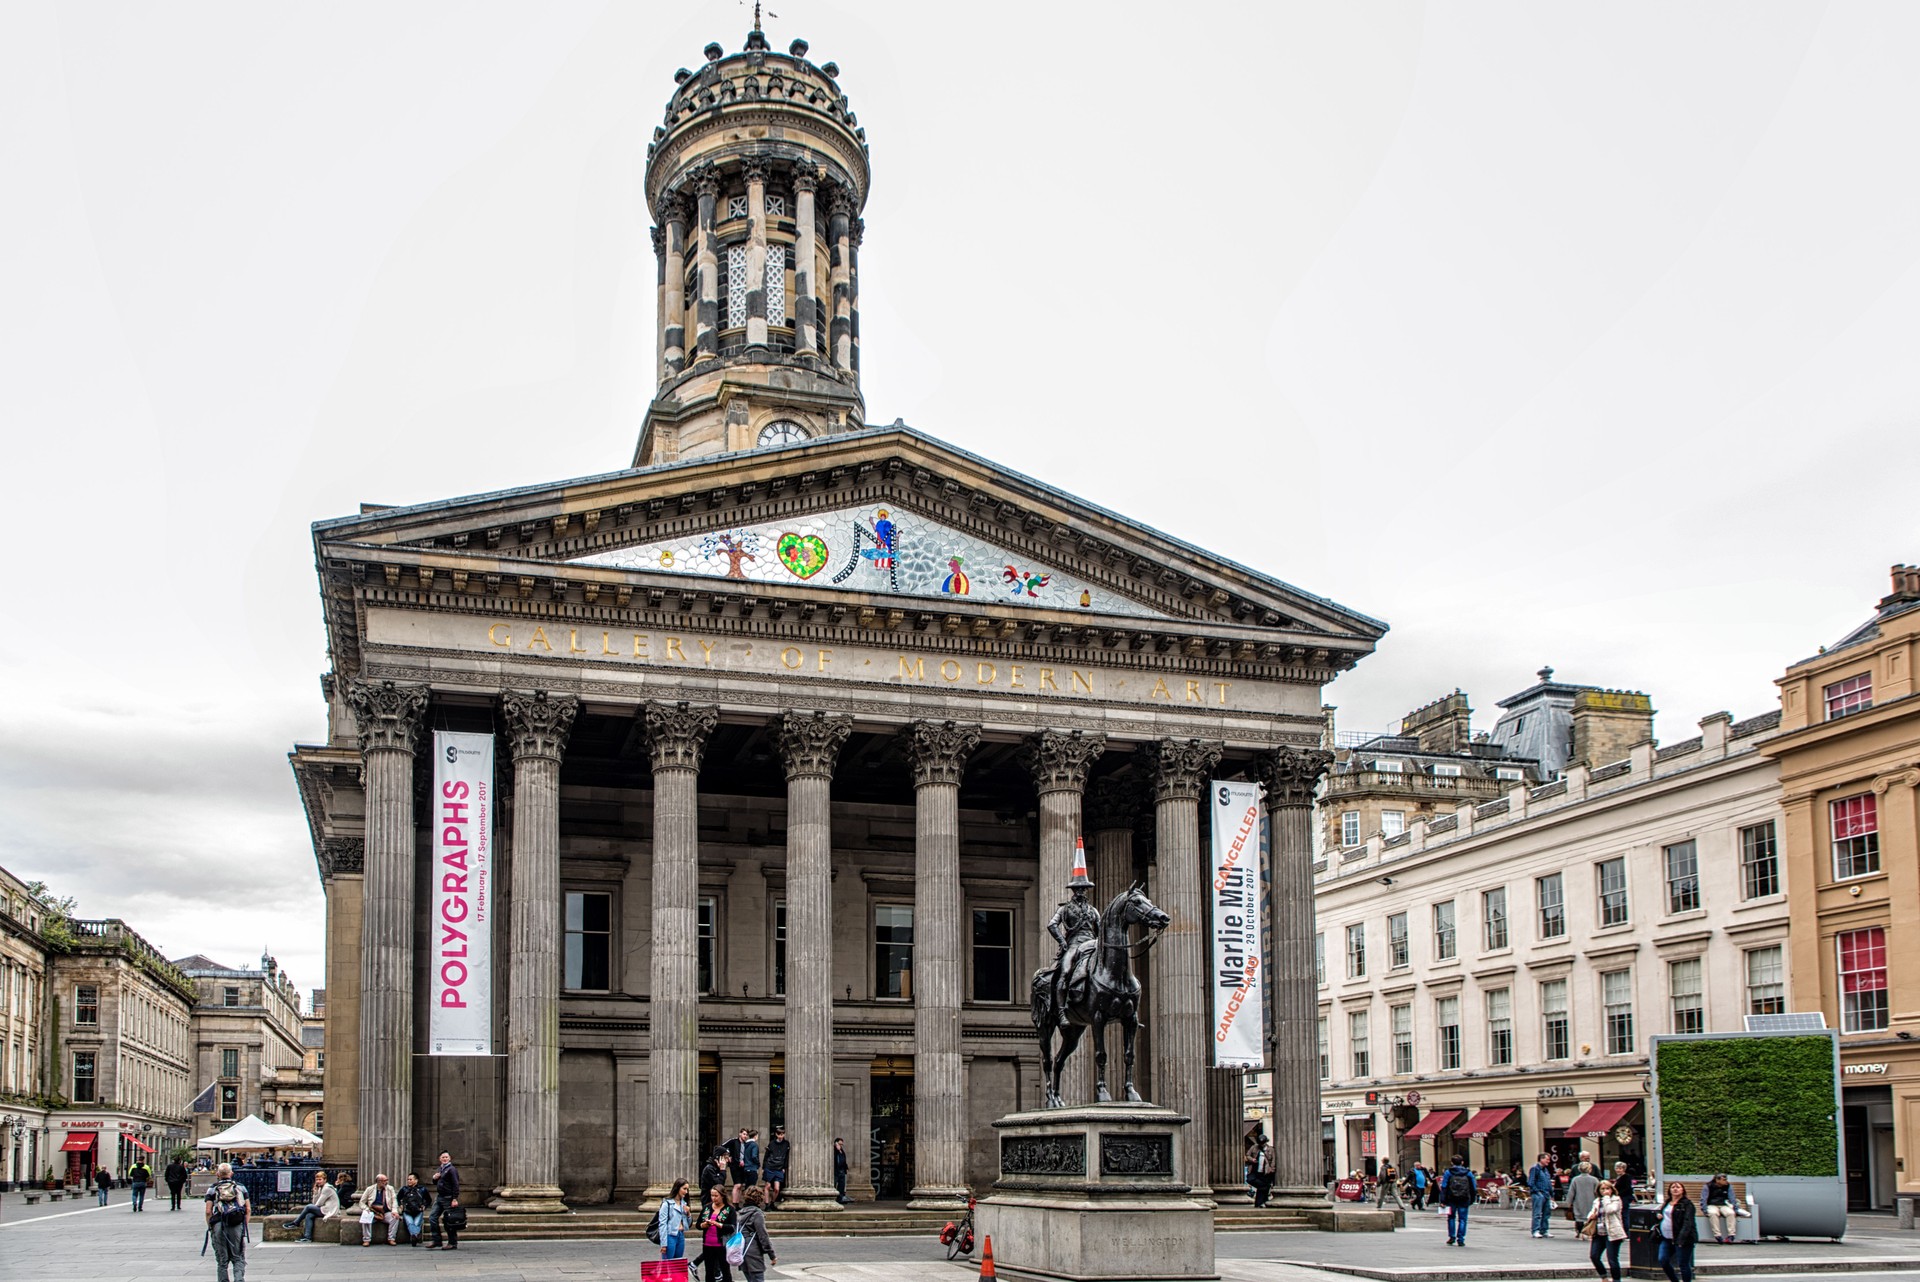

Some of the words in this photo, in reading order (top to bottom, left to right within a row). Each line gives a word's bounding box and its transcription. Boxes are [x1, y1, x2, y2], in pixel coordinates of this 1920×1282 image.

[488, 623, 717, 665] GALLERY
[781, 646, 833, 672] OF
[898, 655, 1094, 694] MODERN
[1152, 677, 1233, 705] ART
[479, 781, 487, 801] 2017
[478, 803, 487, 852] September
[477, 854, 486, 862] 17
[1214, 806, 1258, 891] CANCELLED
[441, 780, 469, 1008] POLYGRAPHS
[477, 870, 487, 912] February
[1218, 867, 1243, 907] Mul
[1245, 868, 1254, 889] 2017
[477, 913, 485, 923] 17
[1245, 892, 1255, 930] October
[1218, 915, 1244, 987] Marlie
[1245, 933, 1255, 945] 29
[1216, 956, 1260, 1042] CANCELLED
[1844, 1063, 1889, 1075] money
[1537, 1086, 1574, 1098] COSTA
[1111, 1237, 1186, 1247] WELLINGTON
